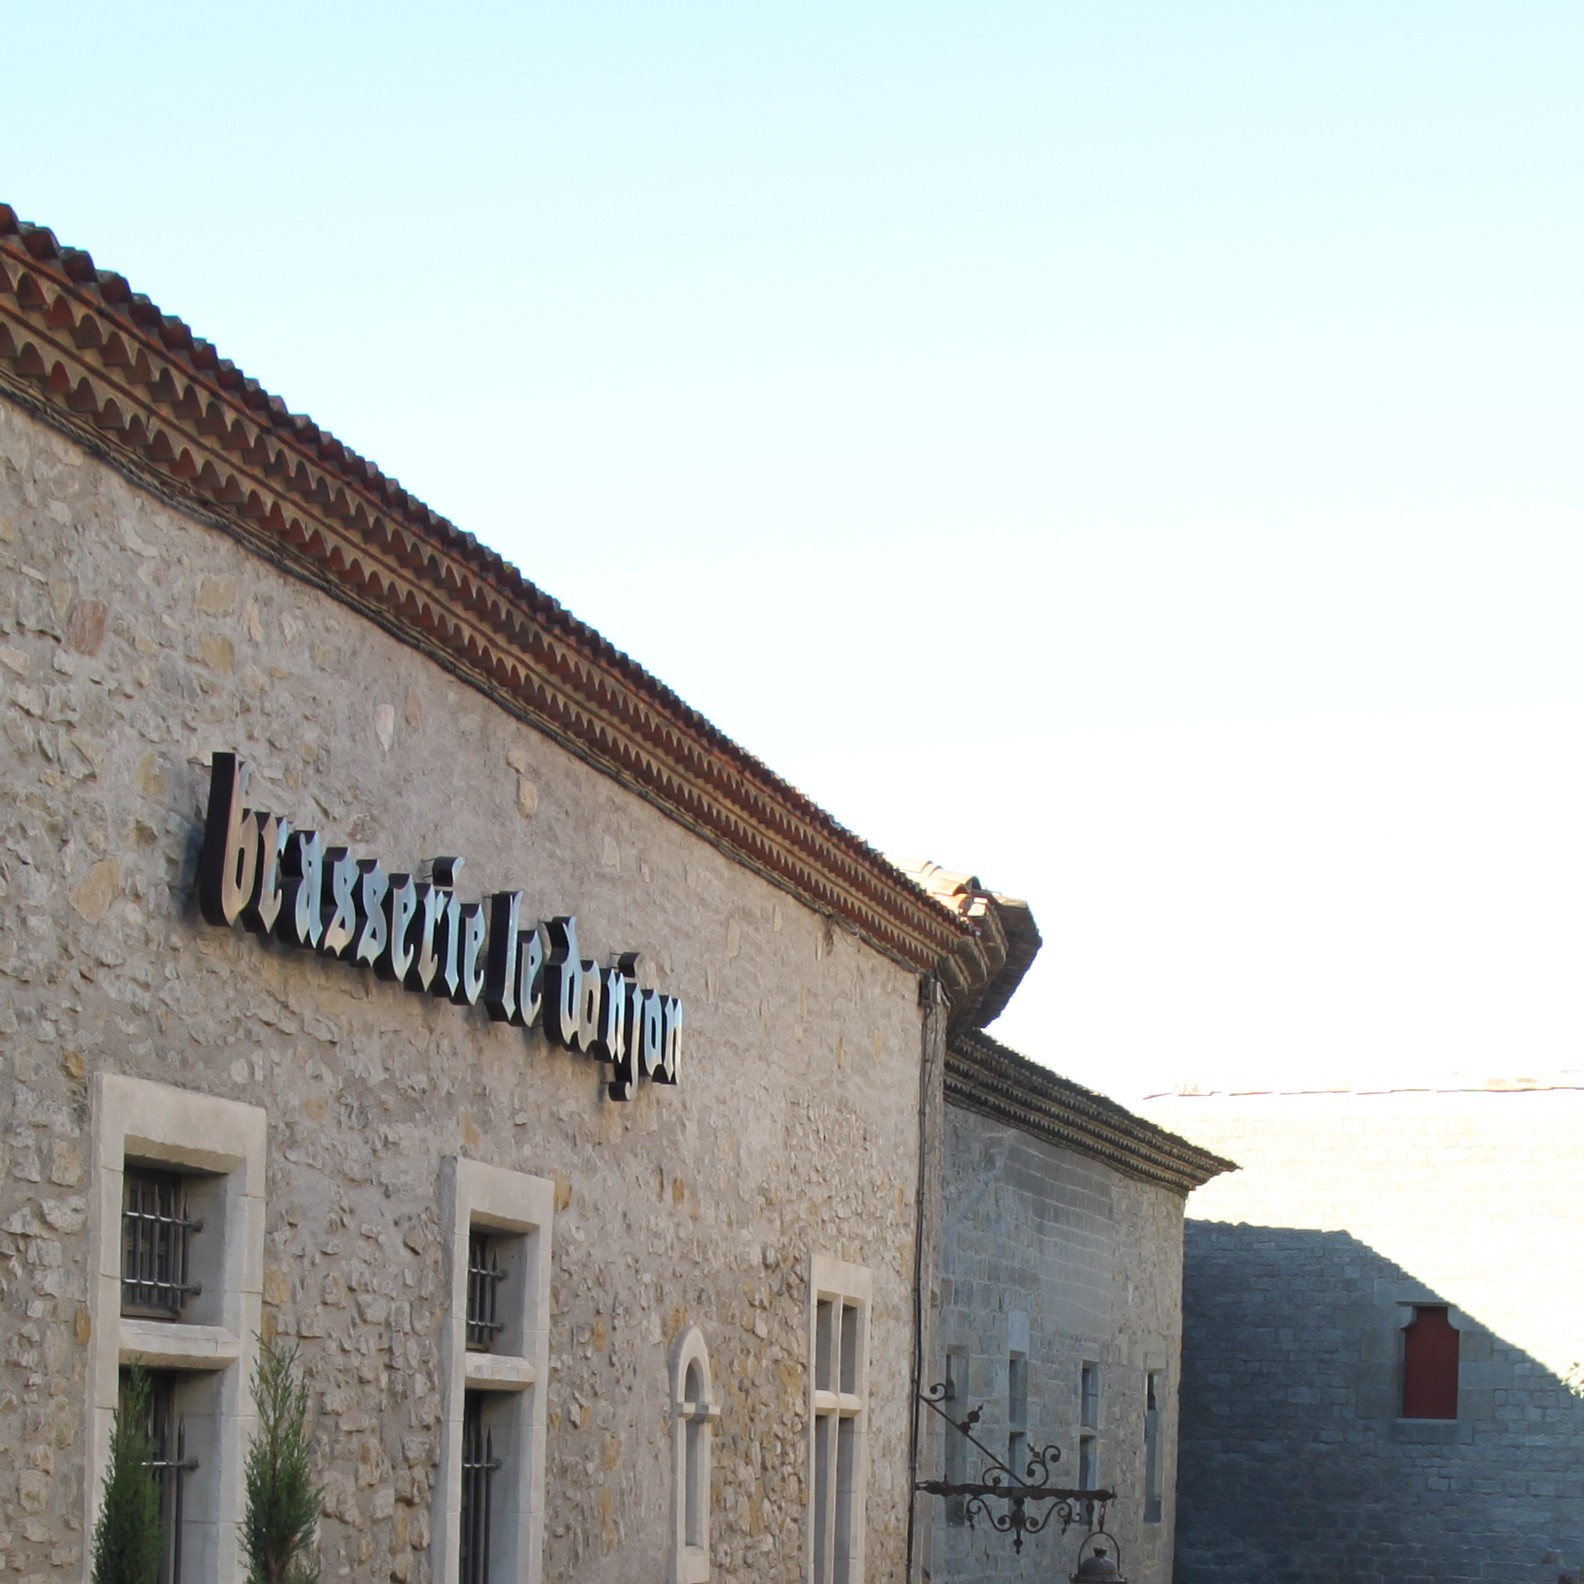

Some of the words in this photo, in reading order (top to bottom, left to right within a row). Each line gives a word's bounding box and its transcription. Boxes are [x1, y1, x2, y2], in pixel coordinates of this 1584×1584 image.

[200, 752, 485, 1006] brasserie
[488, 890, 543, 1027] le
[543, 916, 679, 1101] donjon
